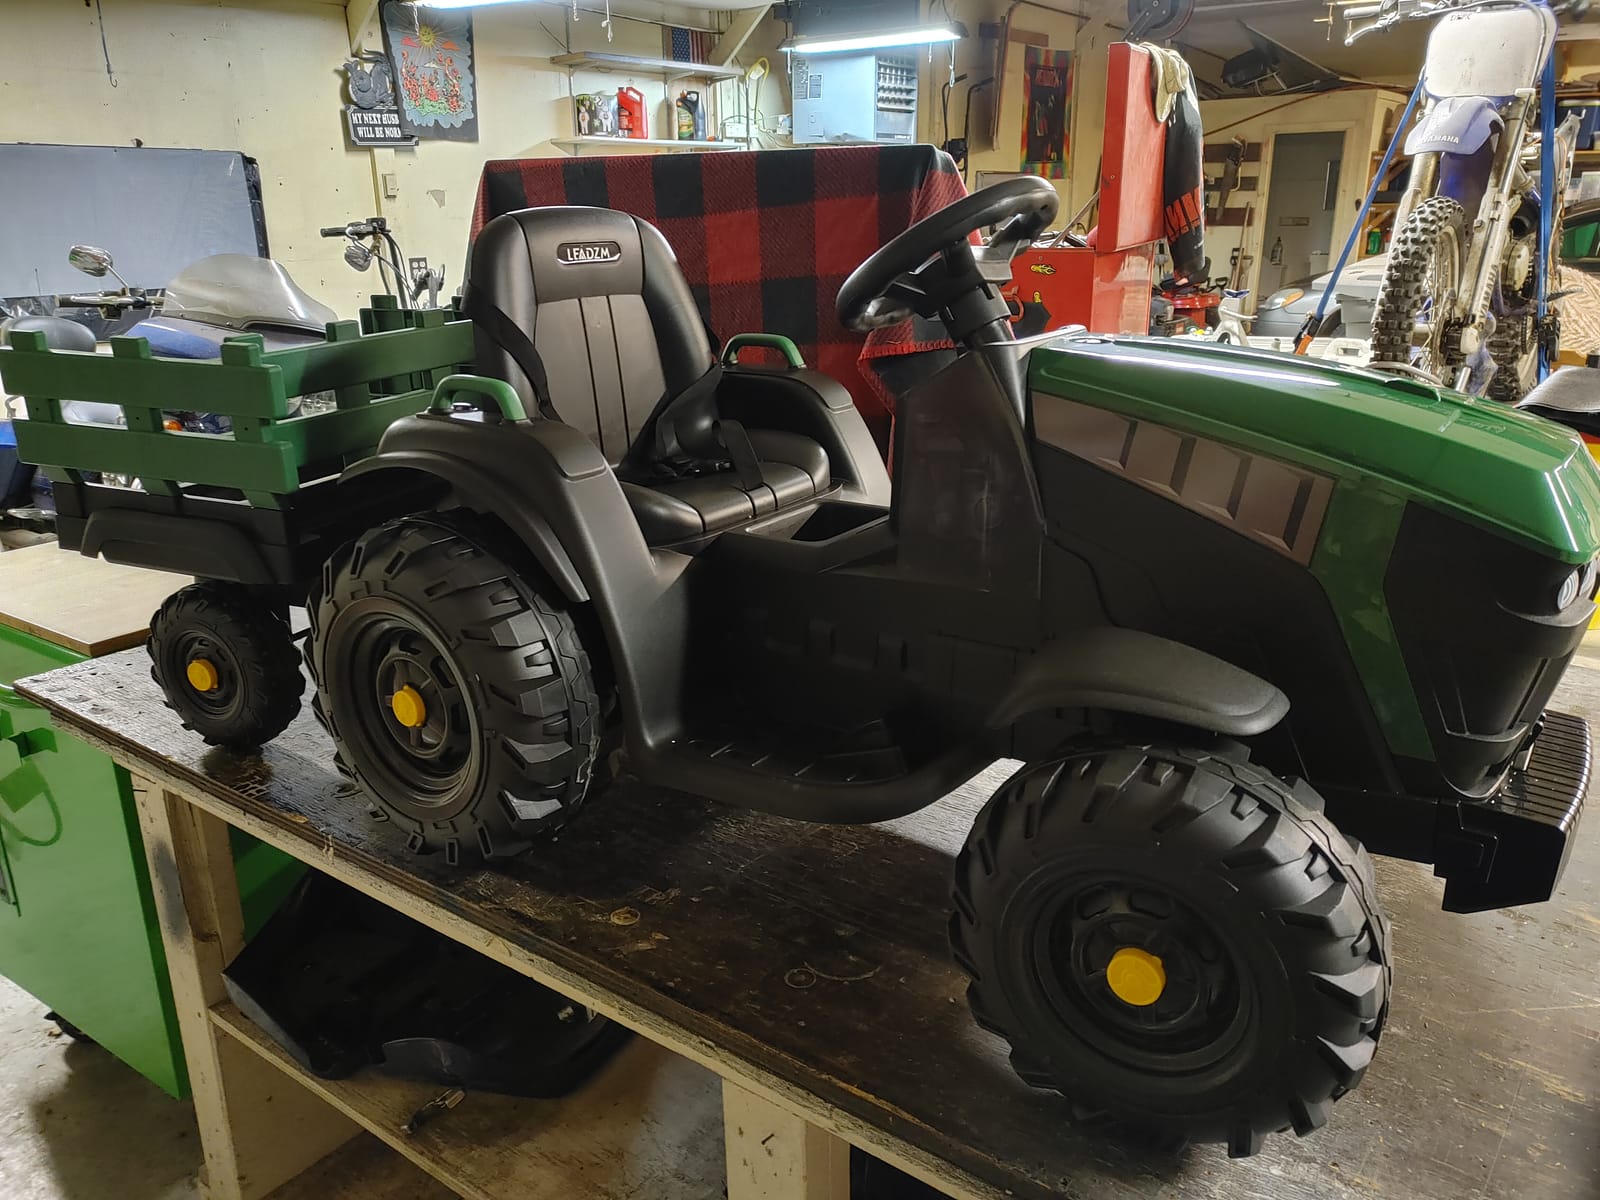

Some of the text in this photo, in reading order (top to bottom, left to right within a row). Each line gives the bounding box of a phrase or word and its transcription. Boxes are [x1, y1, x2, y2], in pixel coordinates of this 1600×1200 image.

[351, 113, 363, 124] MY
[363, 113, 381, 125] NEXT
[356, 126, 375, 138] WILL
[375, 126, 384, 138] BE
[1419, 134, 1459, 145] YAMAHA
[566, 246, 610, 261] LEADZM
[1479, 263, 1498, 319] YAMAHA
